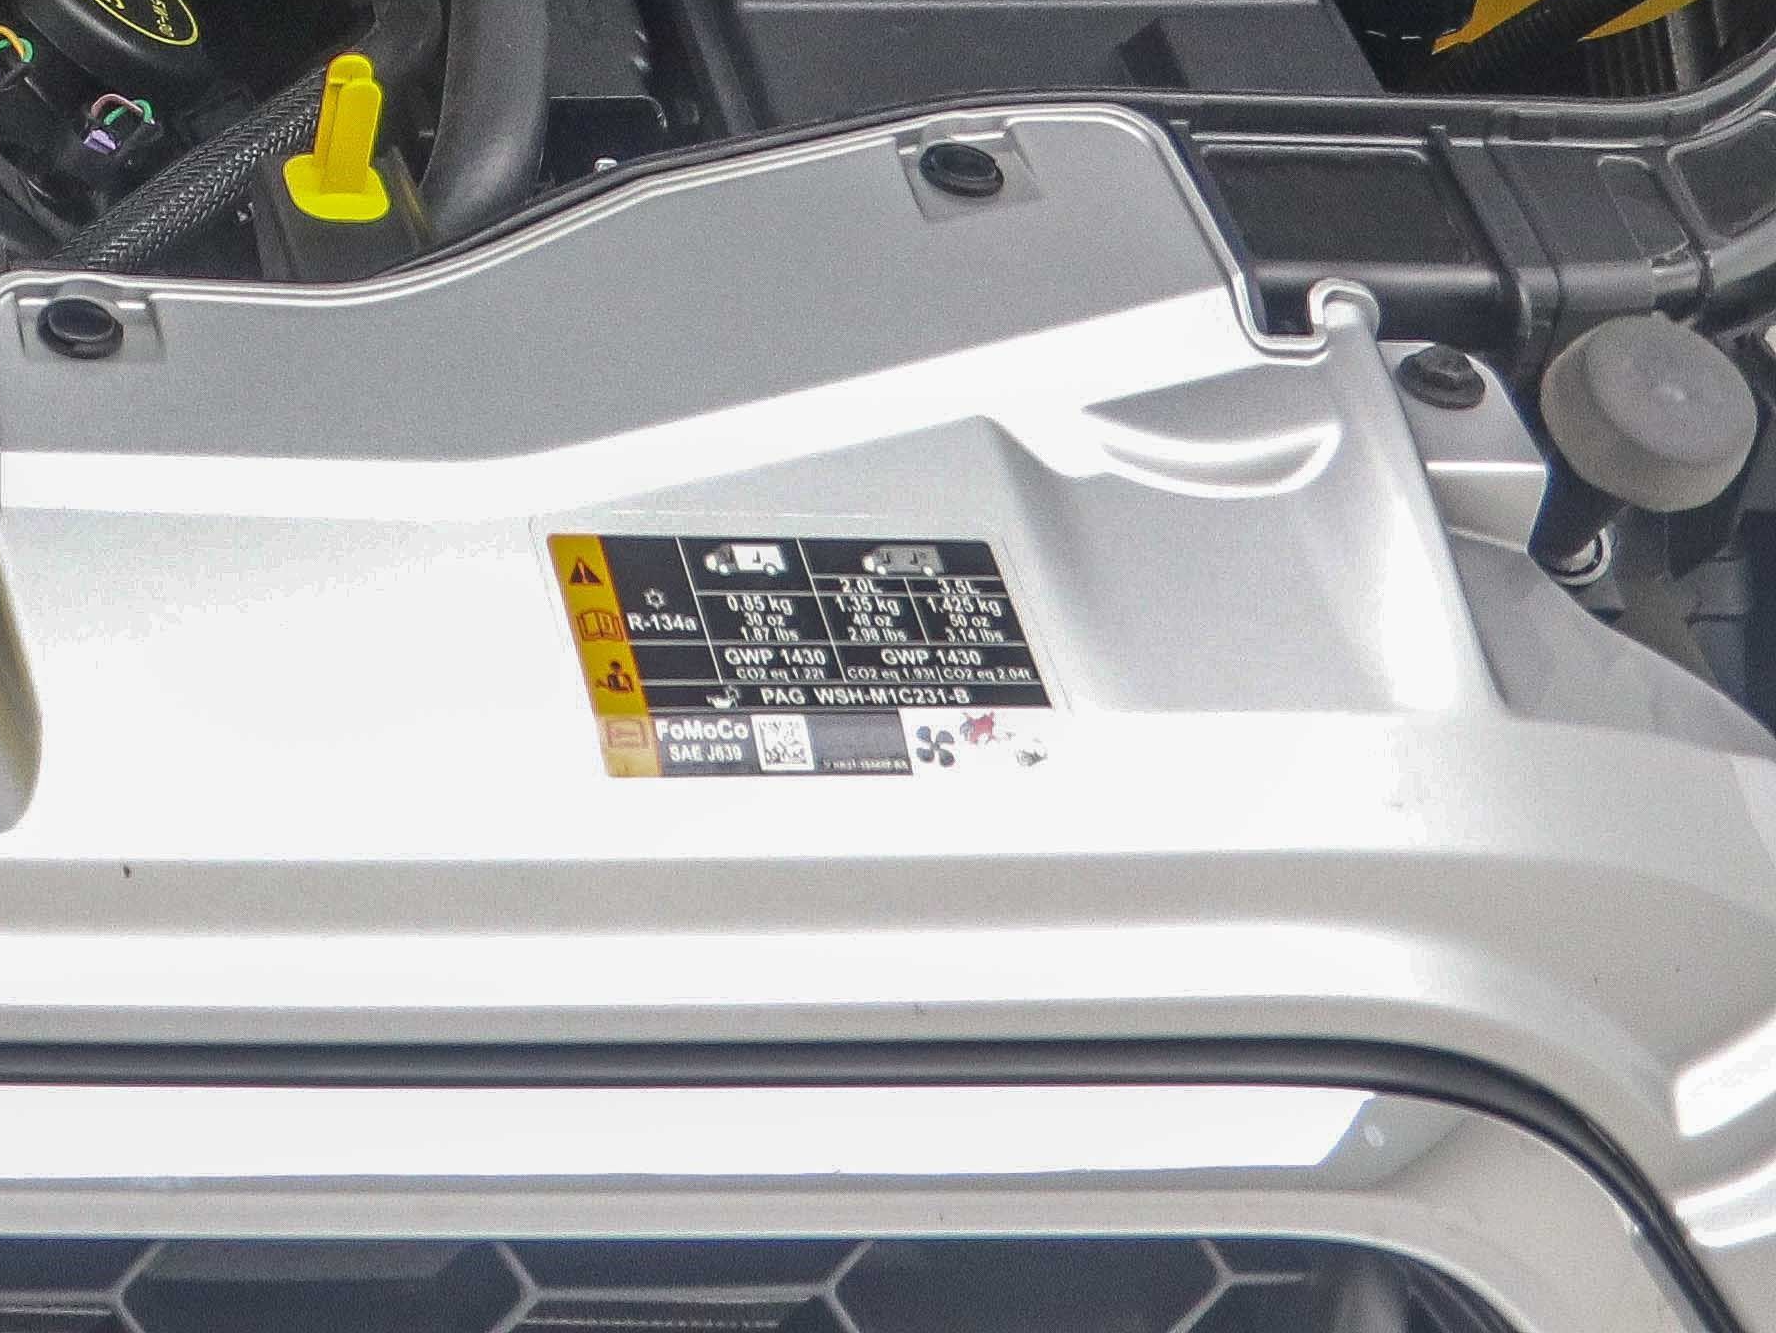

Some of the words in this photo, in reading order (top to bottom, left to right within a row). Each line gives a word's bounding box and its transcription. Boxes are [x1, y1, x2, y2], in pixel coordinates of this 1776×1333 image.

[839, 578, 882, 593] 2.0L
[937, 578, 980, 594] 3.5L
[726, 594, 765, 612] 0.85
[767, 594, 793, 615] kg
[835, 596, 873, 613] 1.35
[874, 596, 901, 616] kg
[927, 596, 974, 613] 1.425
[977, 596, 1003, 617] kg
[626, 613, 698, 632] R-134a
[744, 612, 763, 626] 30
[767, 614, 786, 627] oz
[875, 616, 893, 627] oz
[971, 617, 991, 628] oz
[774, 627, 800, 642] lbs
[883, 628, 907, 642] lbs
[944, 628, 977, 643] 3.14
[979, 628, 1004, 643] lbs
[724, 648, 774, 665] GWP
[779, 648, 826, 665] 1430
[880, 649, 929, 666] GWP
[936, 649, 982, 666] 1430
[736, 667, 765, 680] CO2
[847, 667, 878, 680] CO2
[882, 669, 901, 683] eq
[944, 668, 973, 680] CO2
[977, 670, 996, 683] eq
[760, 687, 806, 705] PAG
[814, 687, 970, 706] WSH-M1C231-B
[655, 718, 749, 741] FoMoCo
[669, 744, 704, 762] SAE
